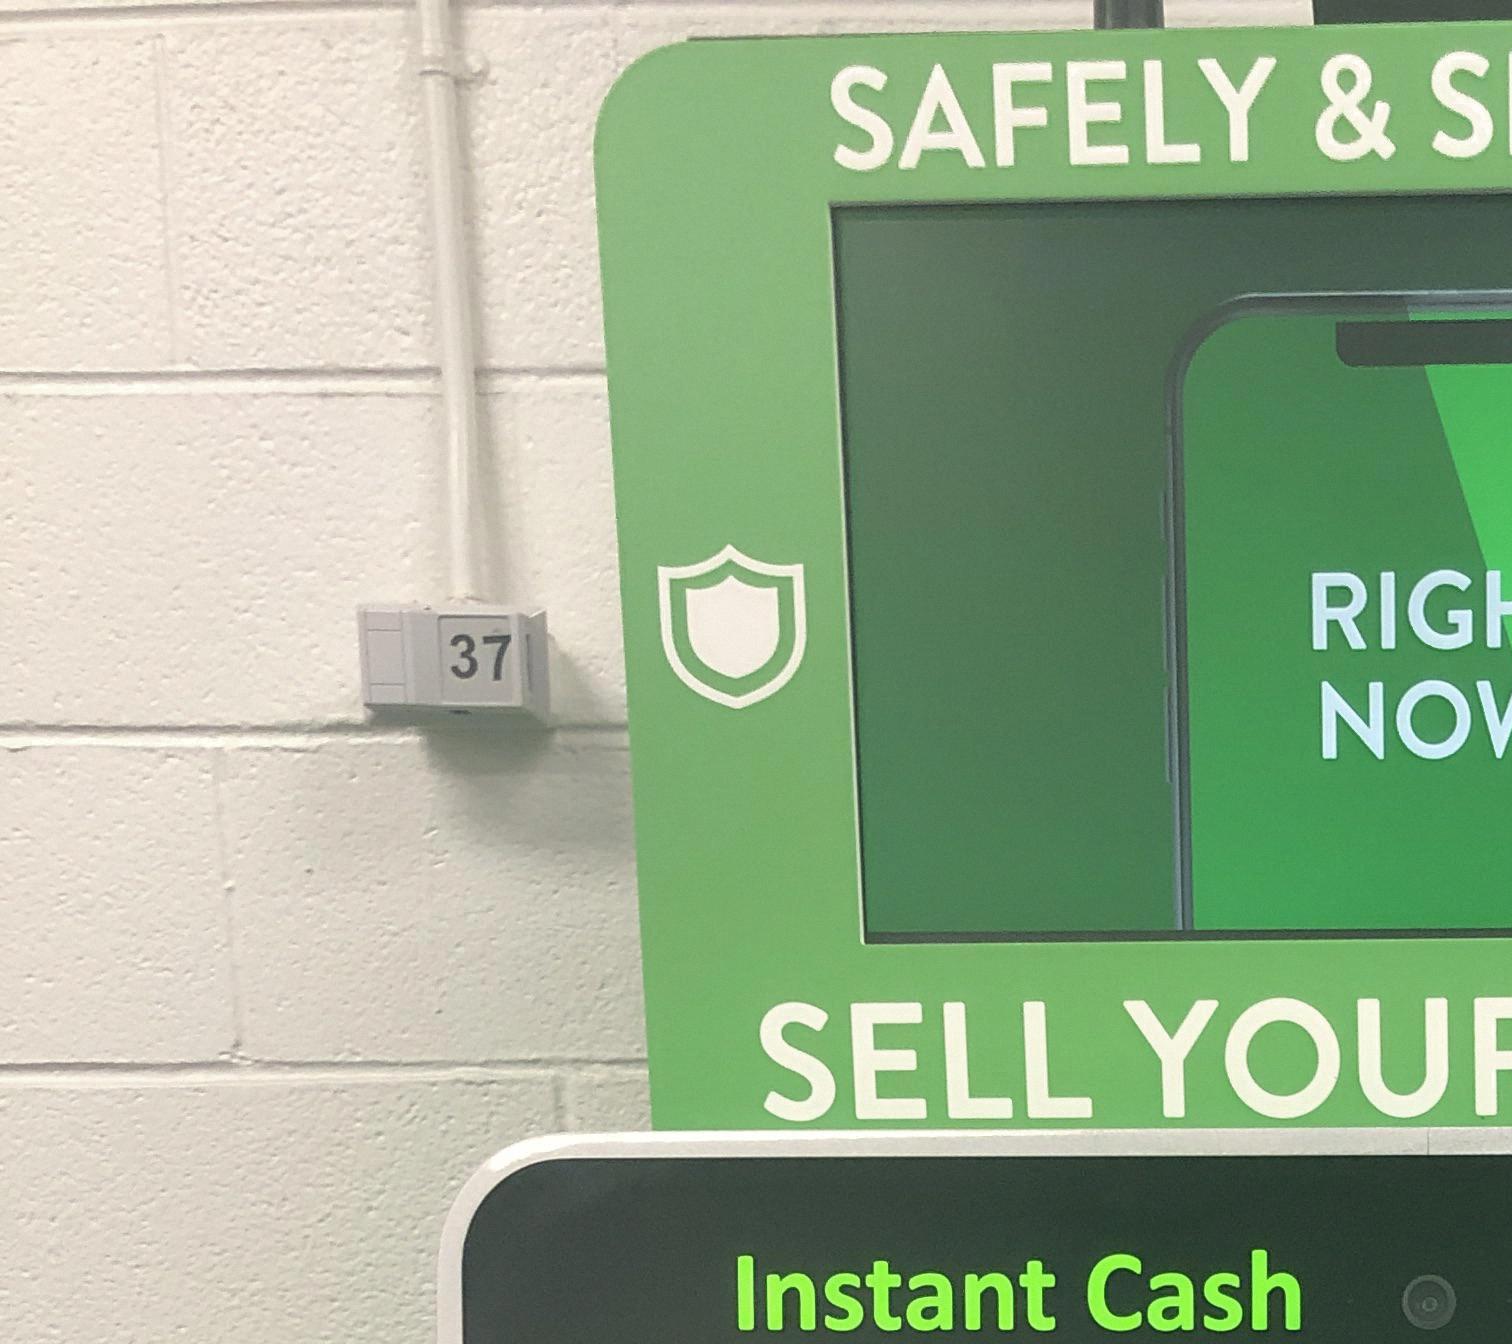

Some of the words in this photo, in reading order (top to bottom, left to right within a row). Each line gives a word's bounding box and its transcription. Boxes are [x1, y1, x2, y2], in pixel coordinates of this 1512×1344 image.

[831, 56, 1277, 171] SAFELY
[1315, 53, 1396, 160] &
[451, 633, 512, 681] 37
[760, 1001, 1092, 1122] SELL
[737, 1255, 1056, 1332] Instant
[1087, 1249, 1302, 1332] Cash
